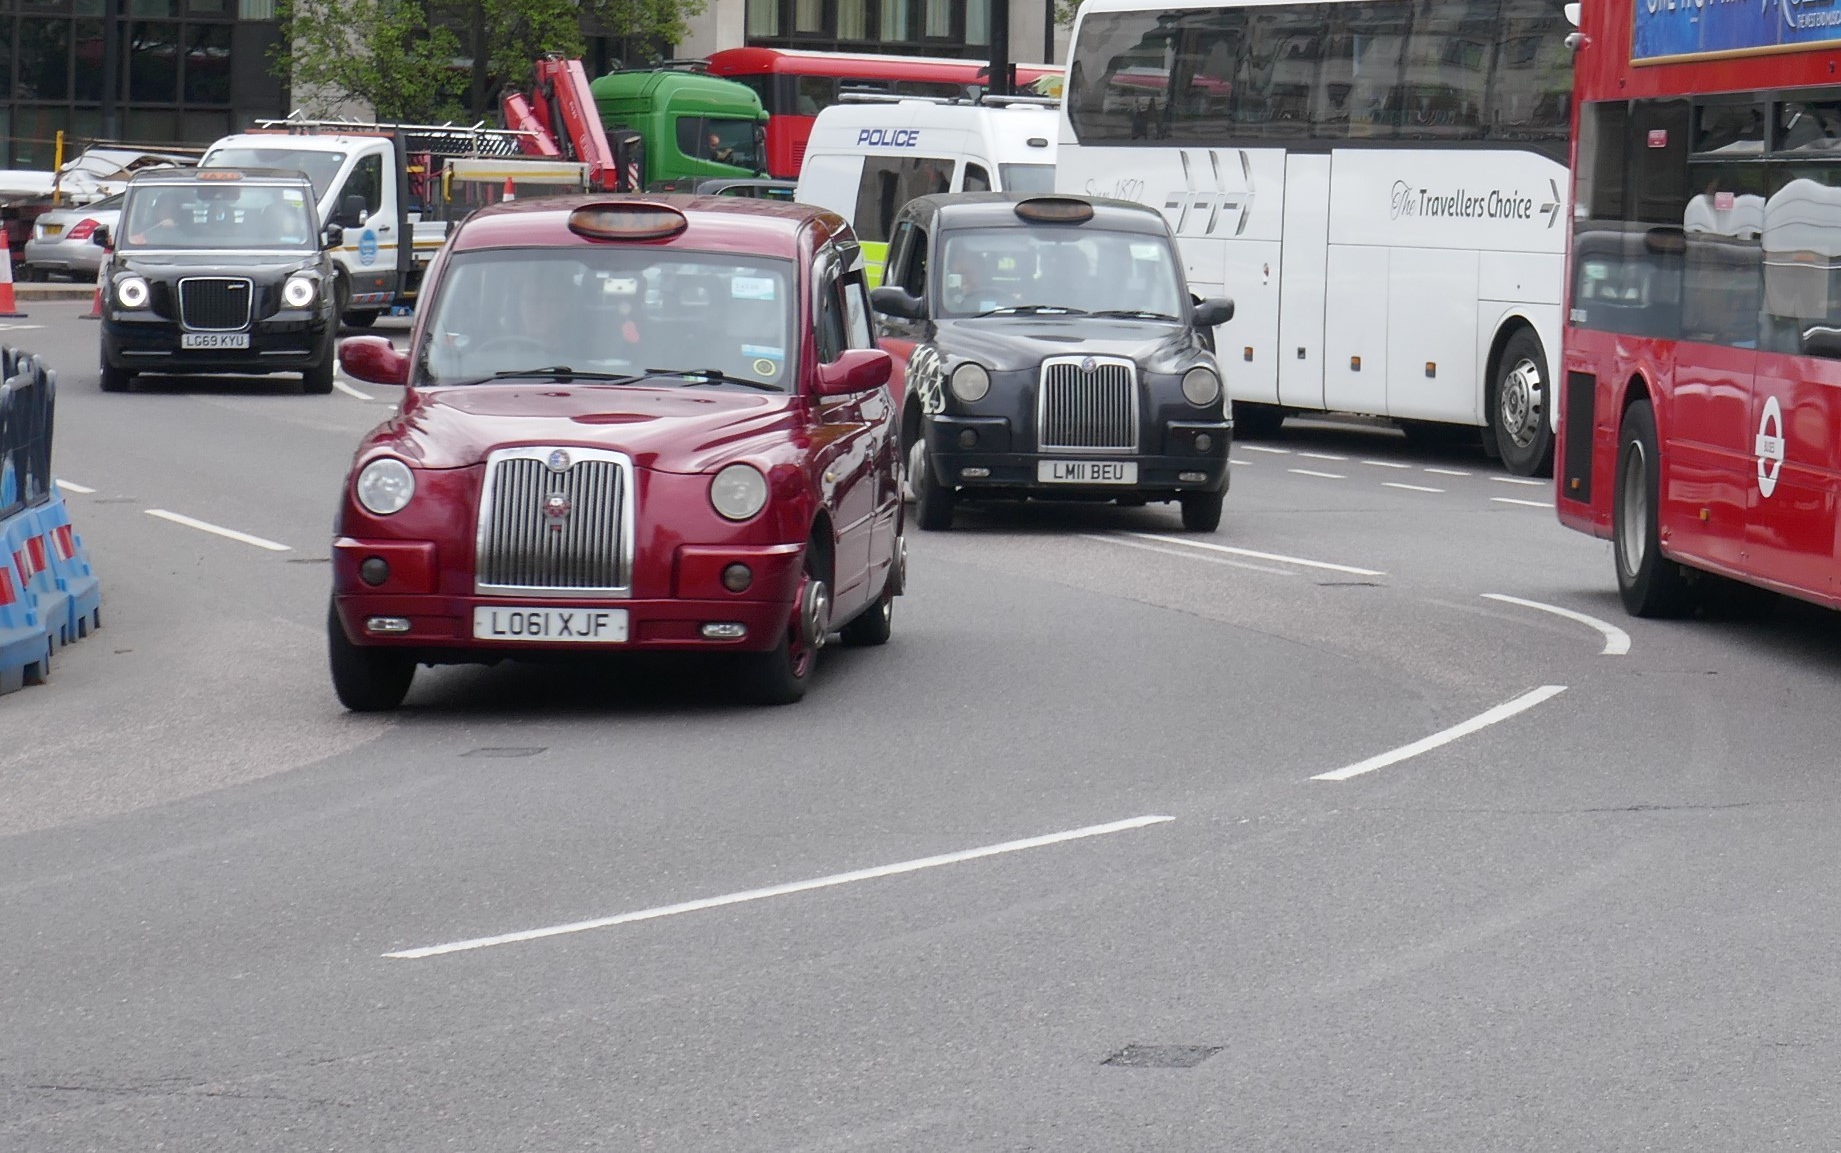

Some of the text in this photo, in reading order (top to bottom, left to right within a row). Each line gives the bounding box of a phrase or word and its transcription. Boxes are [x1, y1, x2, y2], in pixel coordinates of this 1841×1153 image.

[857, 129, 920, 147] POLICE
[1391, 179, 1532, 221] The Travellers Choice
[186, 335, 244, 347] LG69 KYU
[1091, 464, 1124, 480] BEU
[558, 613, 609, 637] XJF
